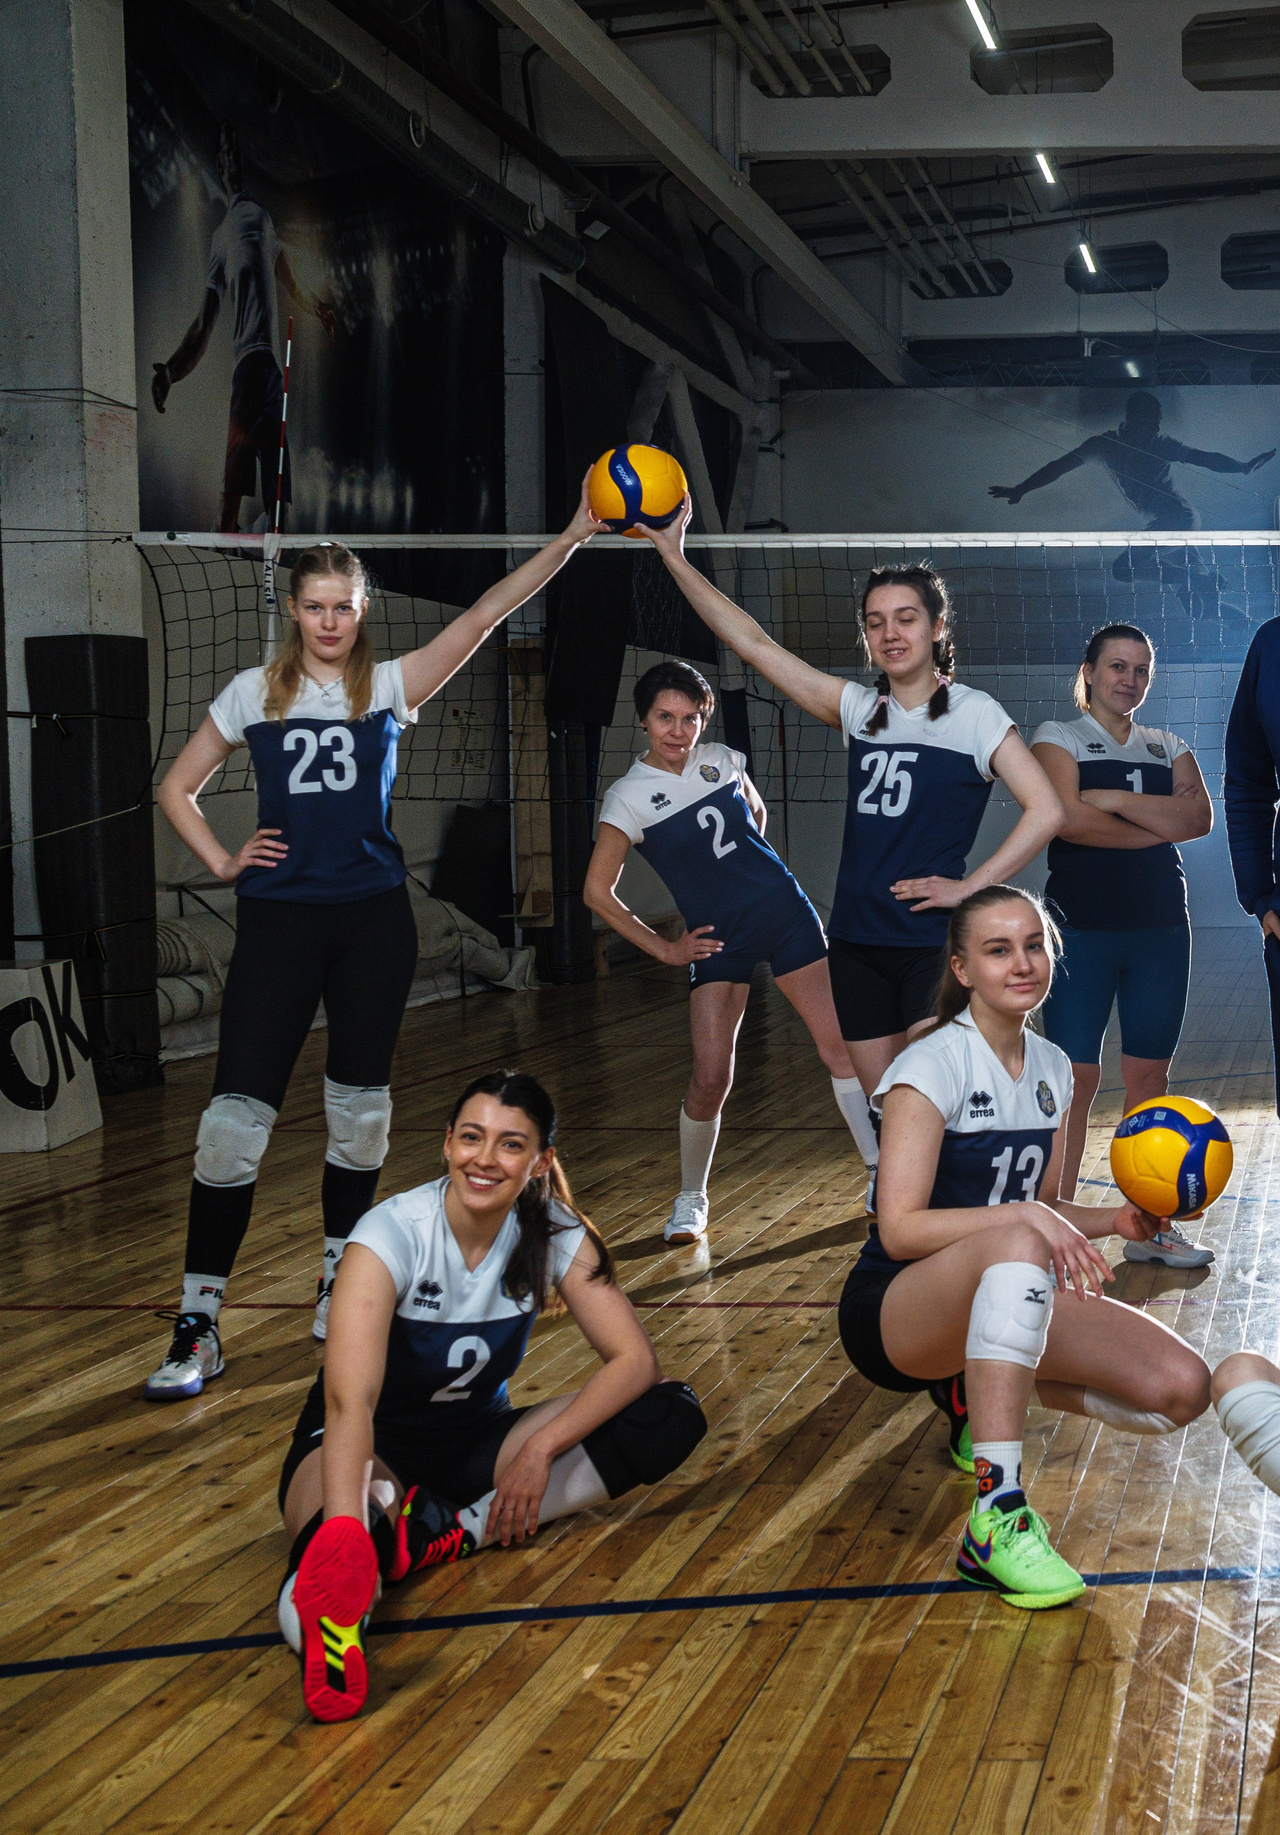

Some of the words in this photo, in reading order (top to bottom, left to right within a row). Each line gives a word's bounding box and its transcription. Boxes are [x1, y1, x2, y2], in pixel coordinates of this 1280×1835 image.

[283, 725, 358, 795] 23
[857, 750, 919, 817] 25
[697, 805, 738, 860] 2
[969, 1108, 995, 1119] errea
[988, 1145, 1044, 1206] 13
[413, 1297, 441, 1311] errea
[430, 1335, 491, 1403] 2
